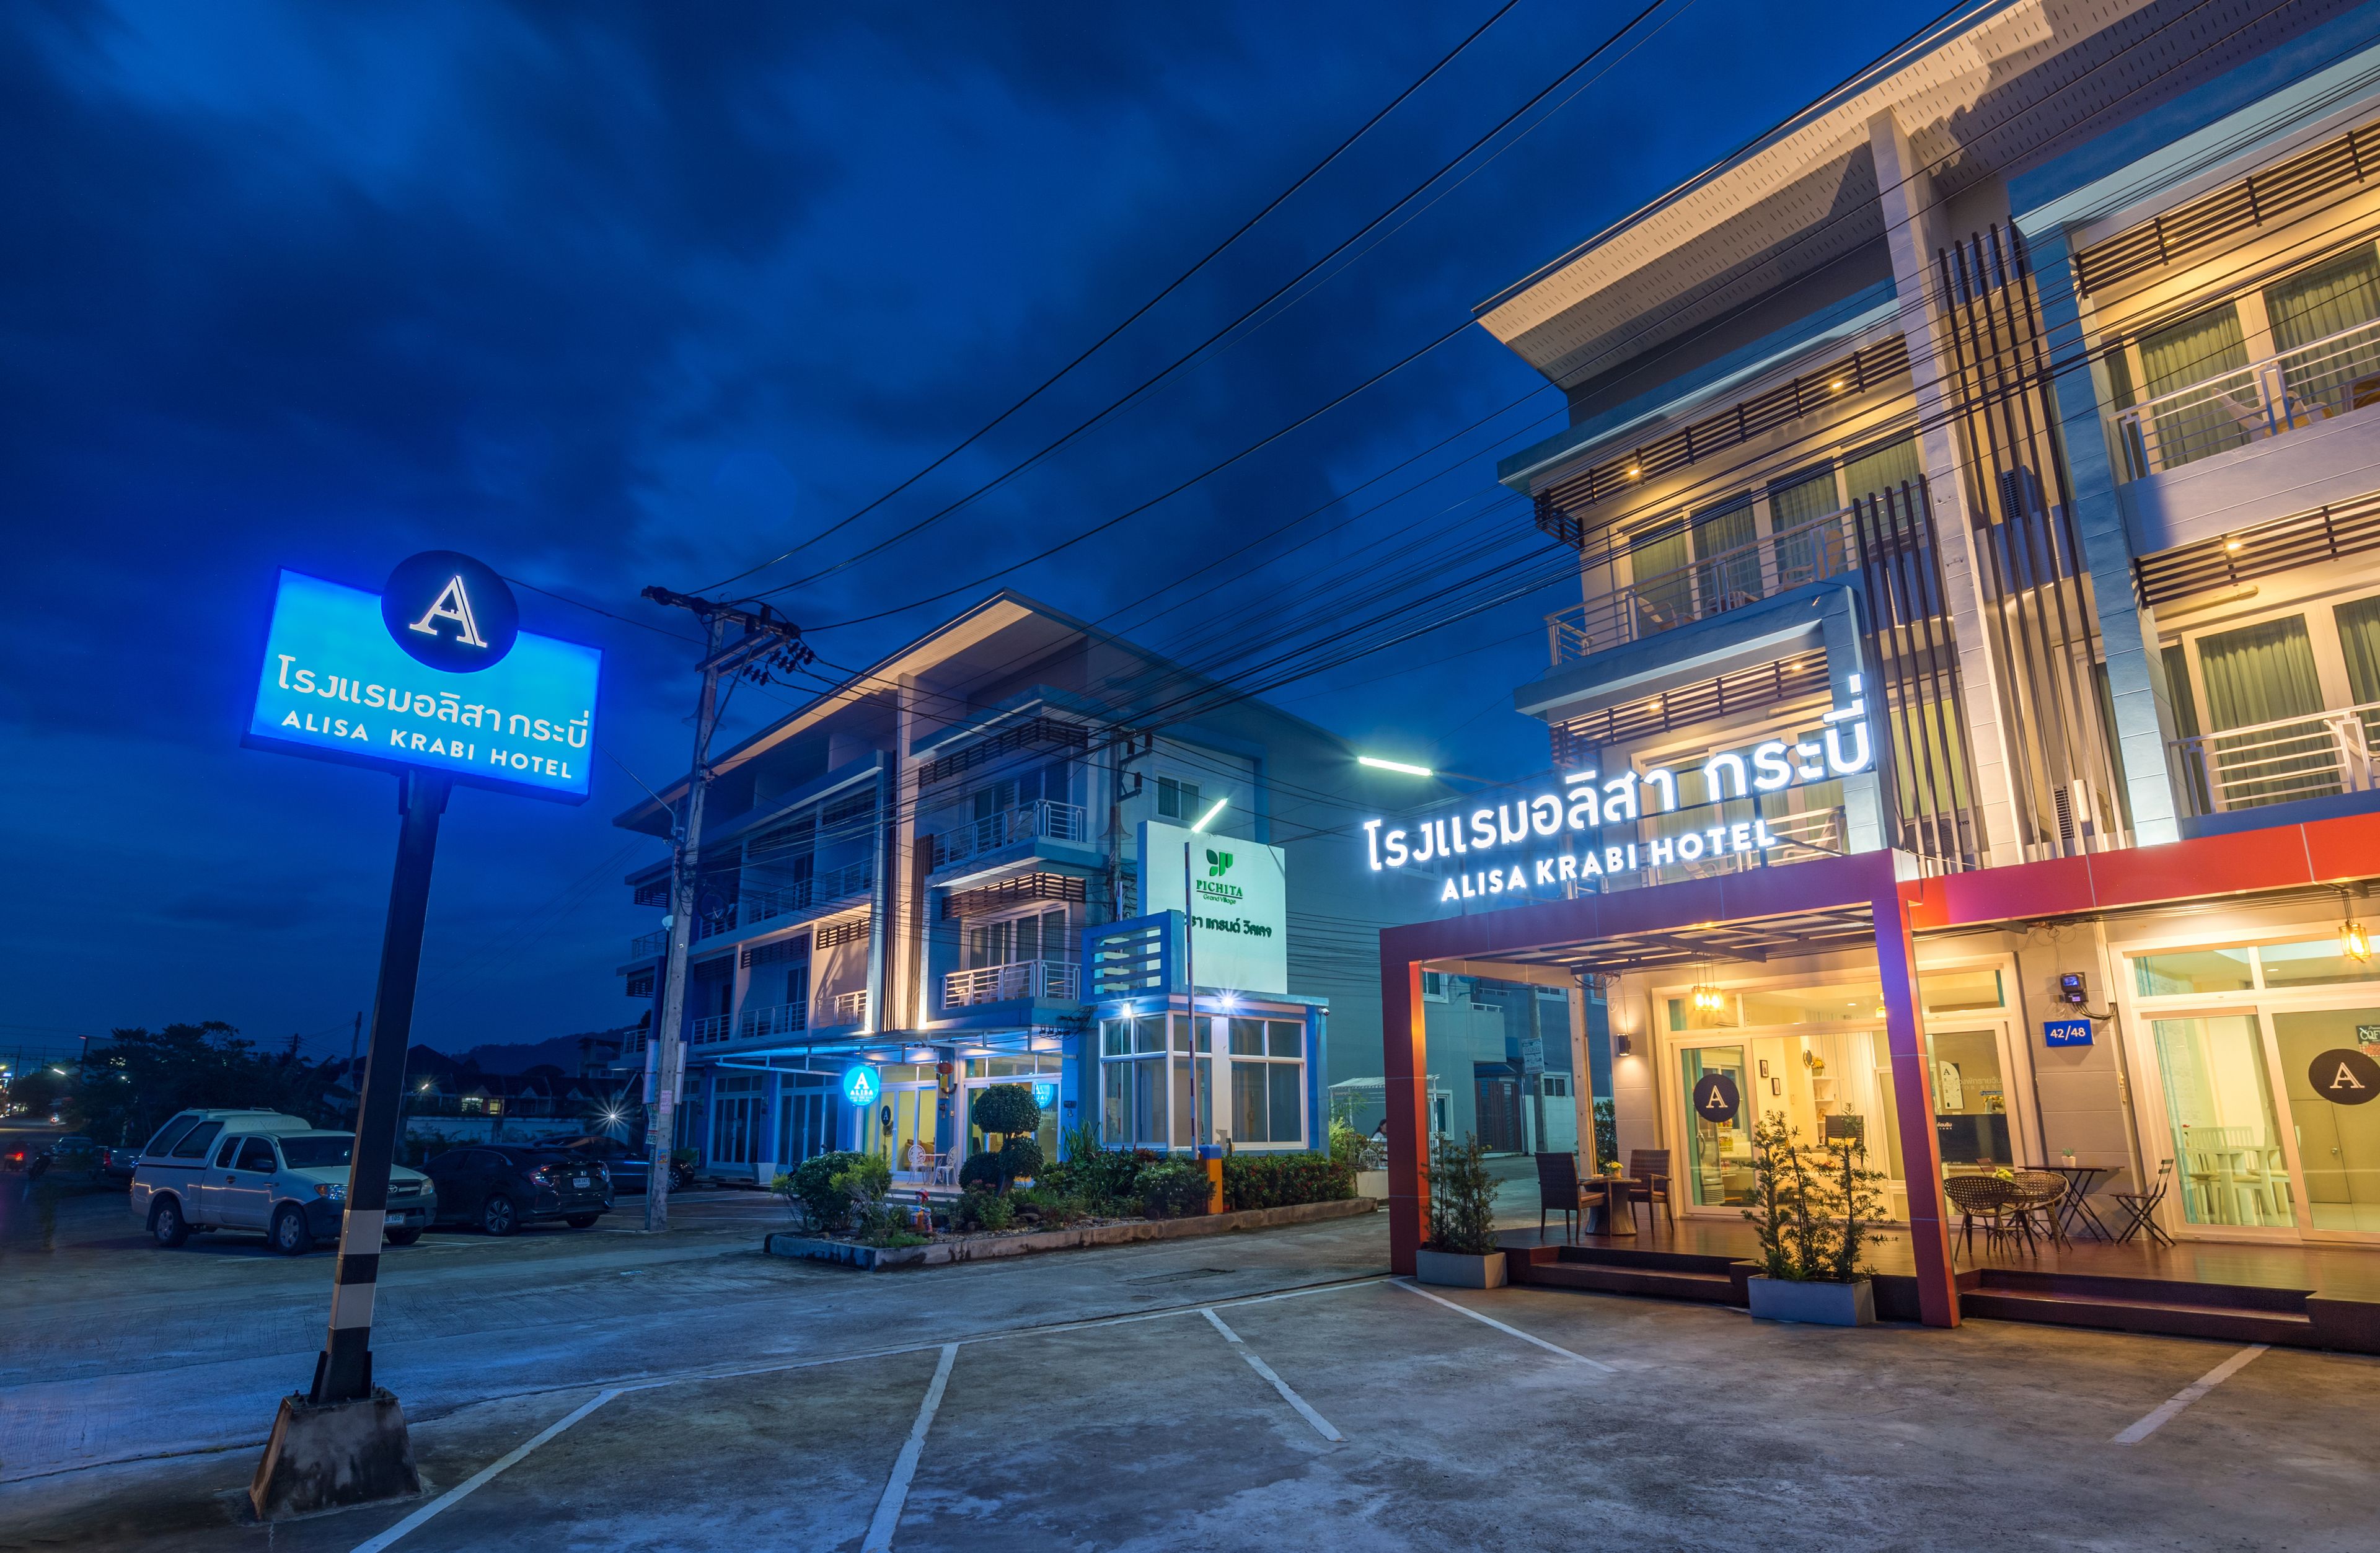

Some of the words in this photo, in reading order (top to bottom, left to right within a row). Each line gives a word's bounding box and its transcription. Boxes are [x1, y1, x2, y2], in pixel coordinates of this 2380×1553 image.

[409, 574, 487, 648] A
[281, 710, 369, 742] ALISA
[390, 729, 474, 760] KRABI
[490, 749, 571, 779] HOTEL
[1441, 866, 1527, 902] ALISA
[1536, 843, 1639, 886] KRABI
[1651, 819, 1777, 866] HOTEL
[1196, 879, 1243, 897] PICHITA
[1203, 894, 1220, 902] Grand
[1220, 896, 1236, 905] Village
[2050, 1025, 2086, 1040] 42/48
[854, 1071, 870, 1089] A
[2329, 1062, 2365, 1089] A
[1706, 1084, 1729, 1108] A
